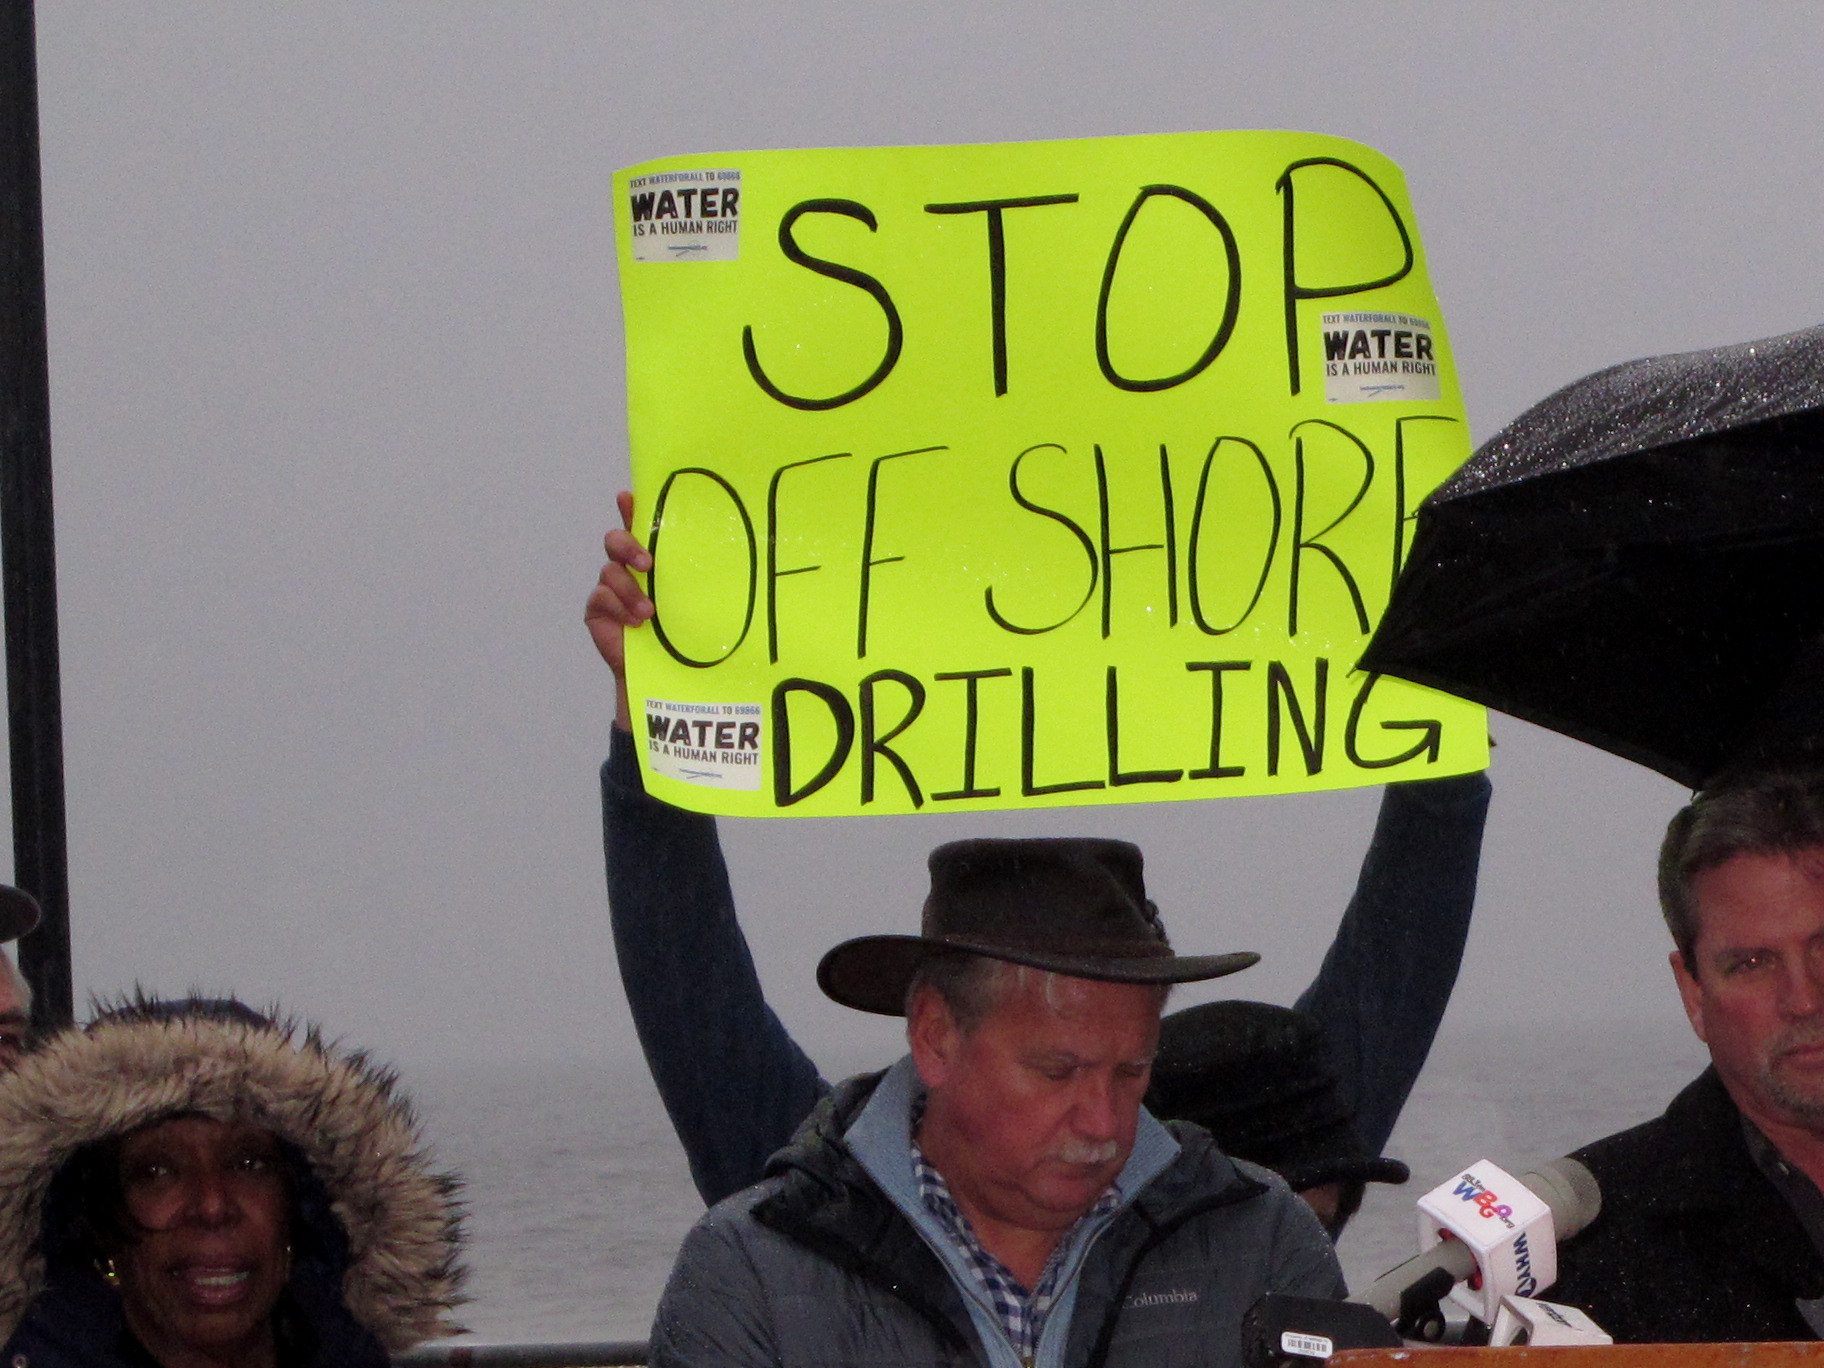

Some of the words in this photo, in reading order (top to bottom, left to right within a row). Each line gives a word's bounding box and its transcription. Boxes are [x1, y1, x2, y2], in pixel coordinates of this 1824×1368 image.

[630, 177, 646, 188] TEXT
[705, 172, 715, 181] TO
[630, 187, 740, 222] WATER
[633, 223, 645, 236] IS
[649, 222, 657, 235] A
[661, 220, 703, 234] HUMAN
[706, 220, 738, 234] RIGHT
[743, 156, 1414, 411] STOP
[1323, 314, 1340, 324] TEXT
[1323, 329, 1434, 361] WATER
[1327, 364, 1337, 376] IS
[1342, 363, 1349, 376] A
[1354, 361, 1397, 375] HUMAN
[1402, 361, 1436, 376] RIGHT
[647, 445, 950, 669] OFF
[646, 699, 663, 710] TEXT
[665, 703, 720, 715] WATERFORALL
[722, 705, 732, 715] TO
[646, 713, 760, 751] WATER
[771, 656, 1442, 810] DRILLING
[649, 739, 659, 752] IS
[662, 744, 670, 755] A
[674, 746, 717, 763] HUMAN
[721, 751, 758, 765] RIGHT
